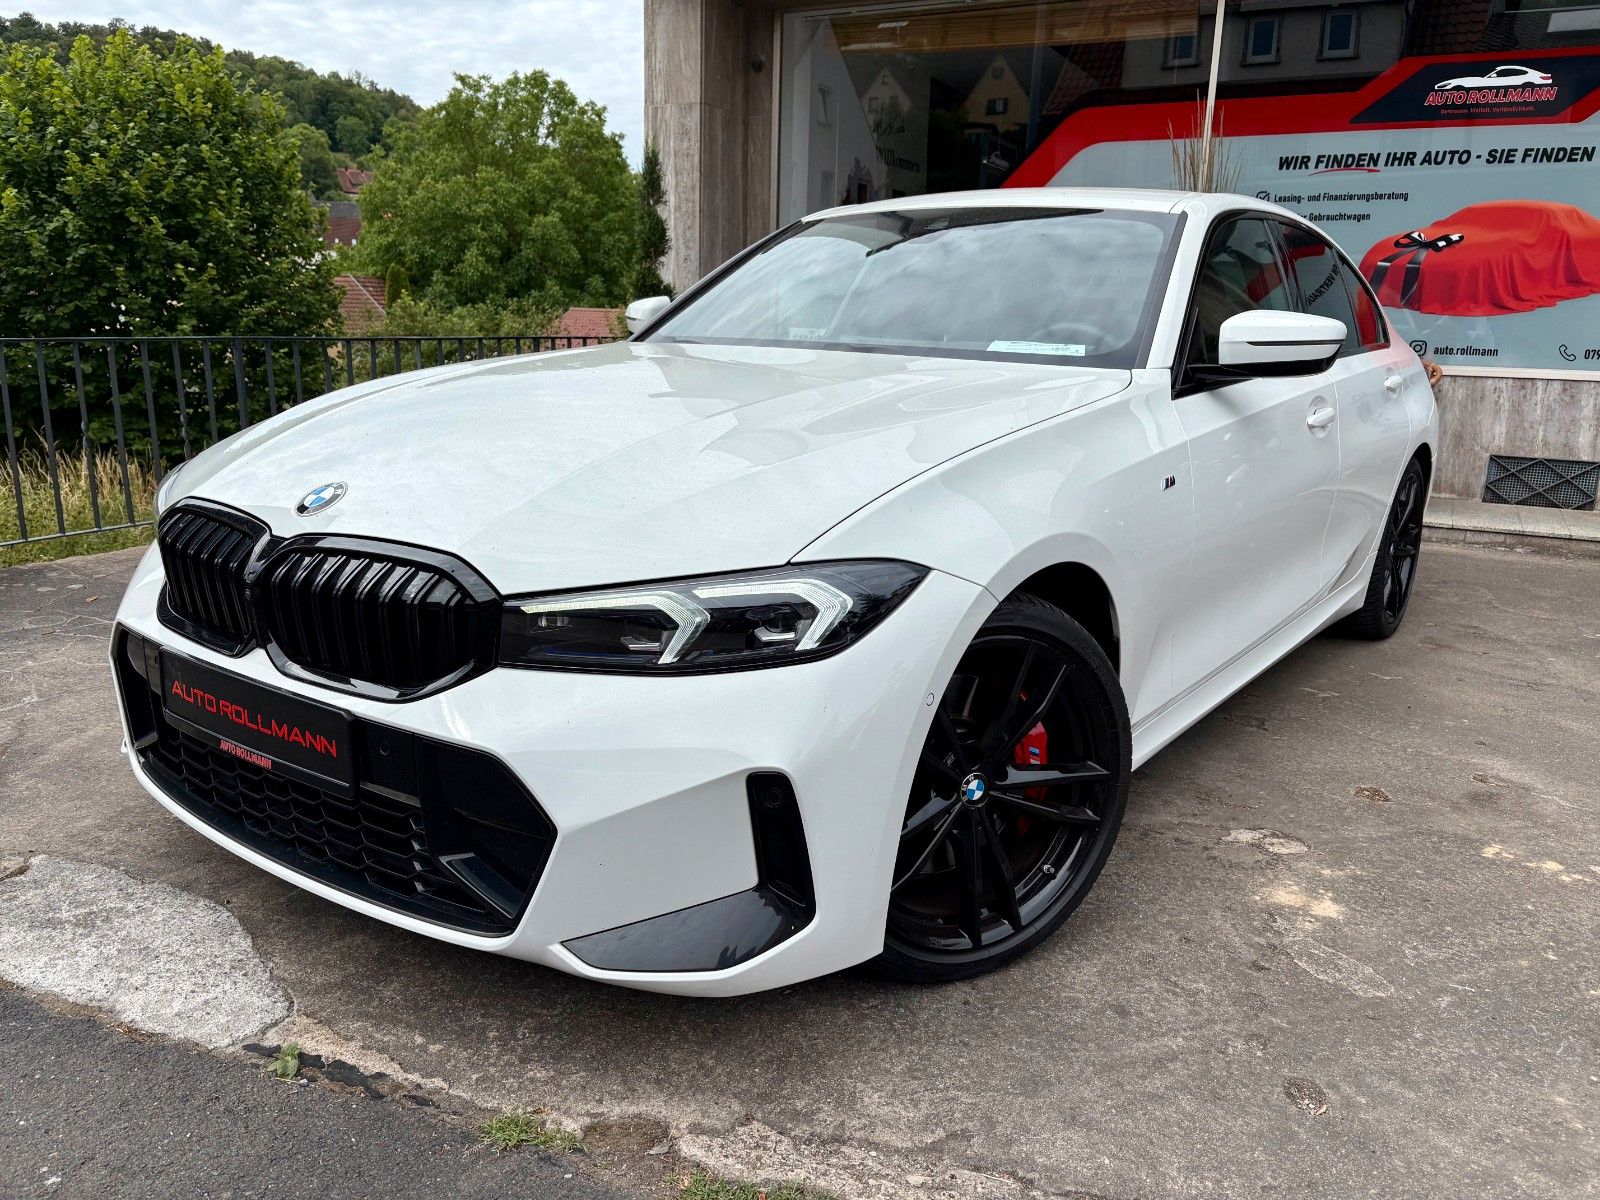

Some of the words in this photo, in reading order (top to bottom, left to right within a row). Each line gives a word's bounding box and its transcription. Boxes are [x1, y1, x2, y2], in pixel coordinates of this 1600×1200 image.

[1424, 90, 1467, 105] AUTO
[1467, 87, 1557, 104] ROLLMANN
[1278, 155, 1311, 170] WIR
[1314, 153, 1381, 169] FINDEN
[1384, 151, 1417, 167] IHR
[1419, 149, 1472, 165] AUTO
[1486, 148, 1518, 164] SIE
[1521, 146, 1596, 163] FINDEN
[1274, 193, 1305, 205] Leasing-
[1307, 193, 1321, 202] und
[1322, 191, 1409, 203] Finanzierungsberatung
[1308, 212, 1371, 223] Gebrauchtwagen
[1433, 345, 1499, 357] auto.rollmann
[171, 680, 217, 713] AUTO
[219, 699, 337, 758] ROLLMANN
[220, 739, 236, 755] AUTO
[236, 746, 272, 770] ROLLMANN
